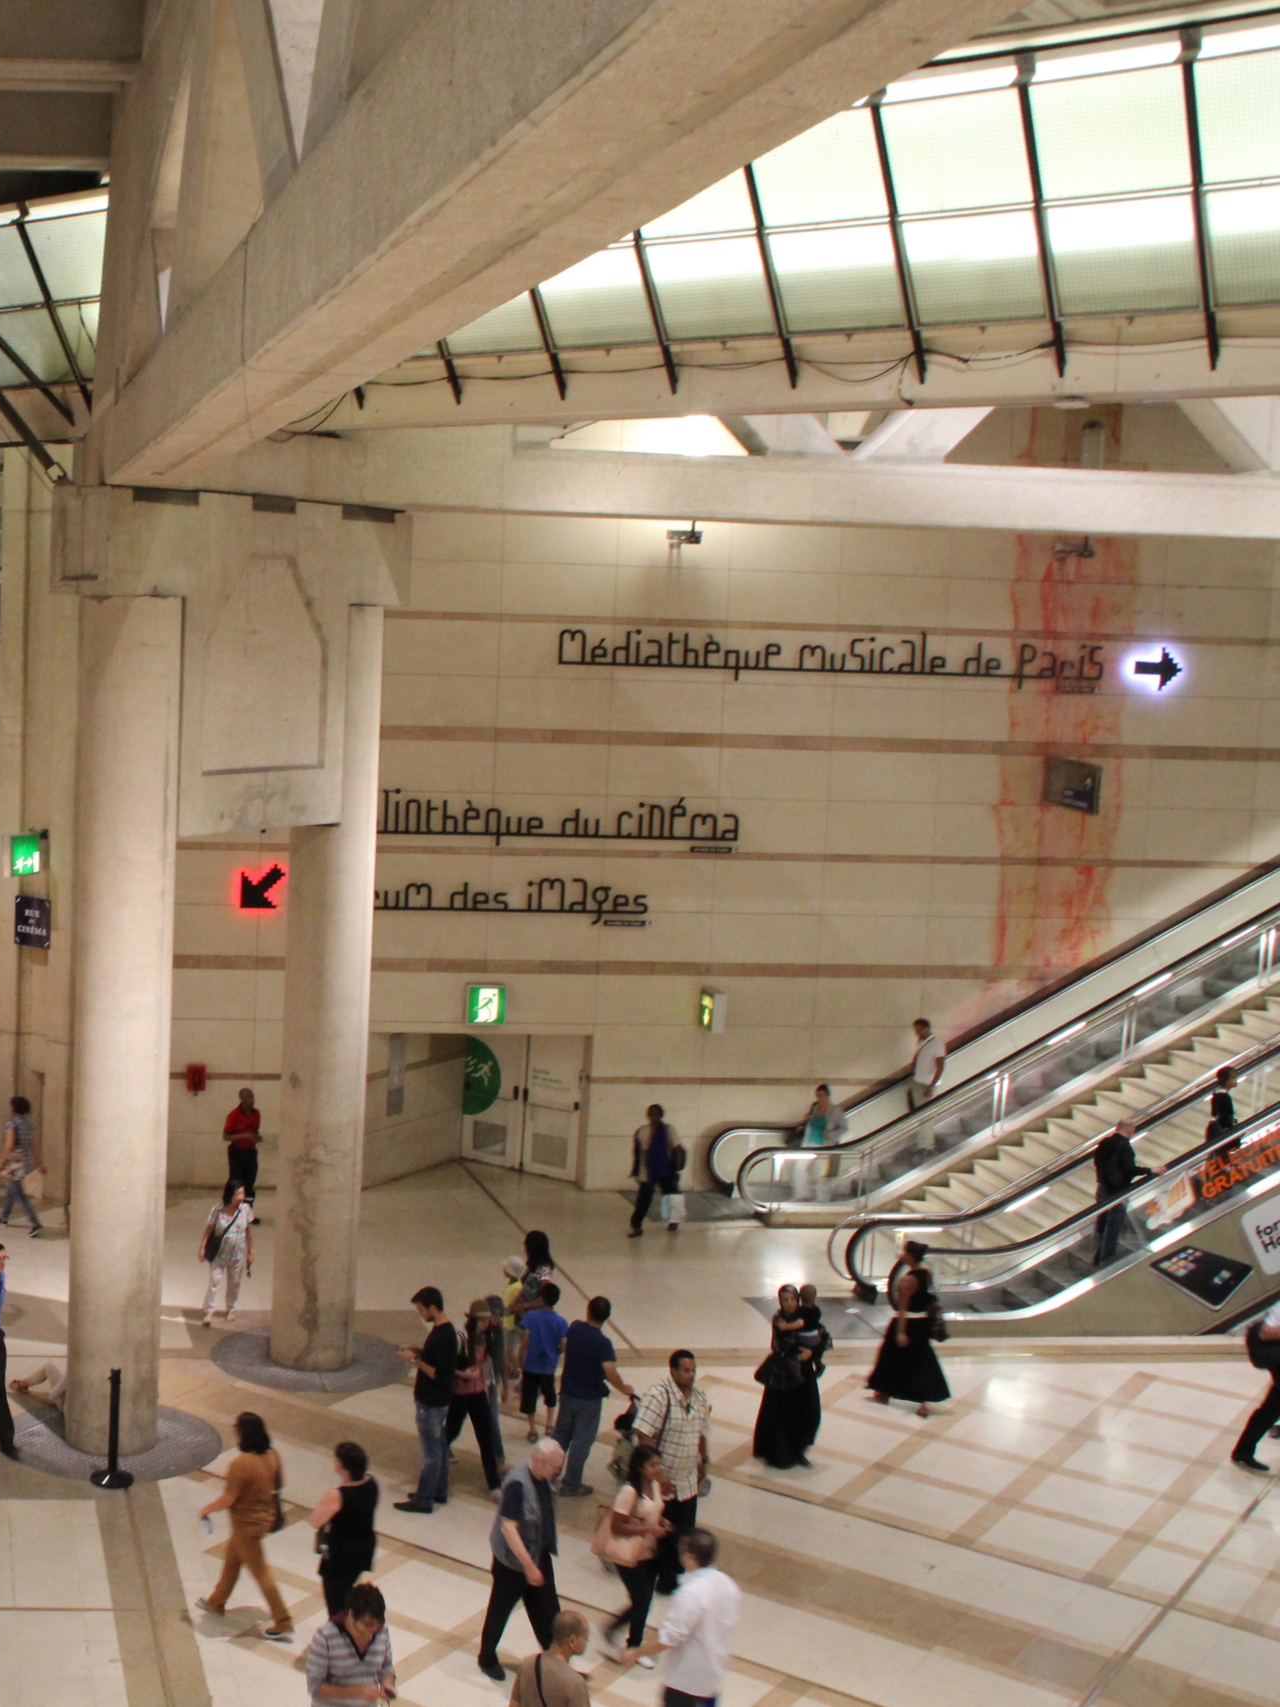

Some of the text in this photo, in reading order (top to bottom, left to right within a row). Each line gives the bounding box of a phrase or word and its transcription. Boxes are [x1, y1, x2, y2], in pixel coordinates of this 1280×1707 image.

[558, 628, 781, 682] Médiathèque
[964, 641, 1002, 678] de
[1017, 642, 1104, 690] Paris
[377, 788, 740, 846] liothèque du cinéma
[25, 909, 40, 918] RUE
[449, 882, 510, 913] des
